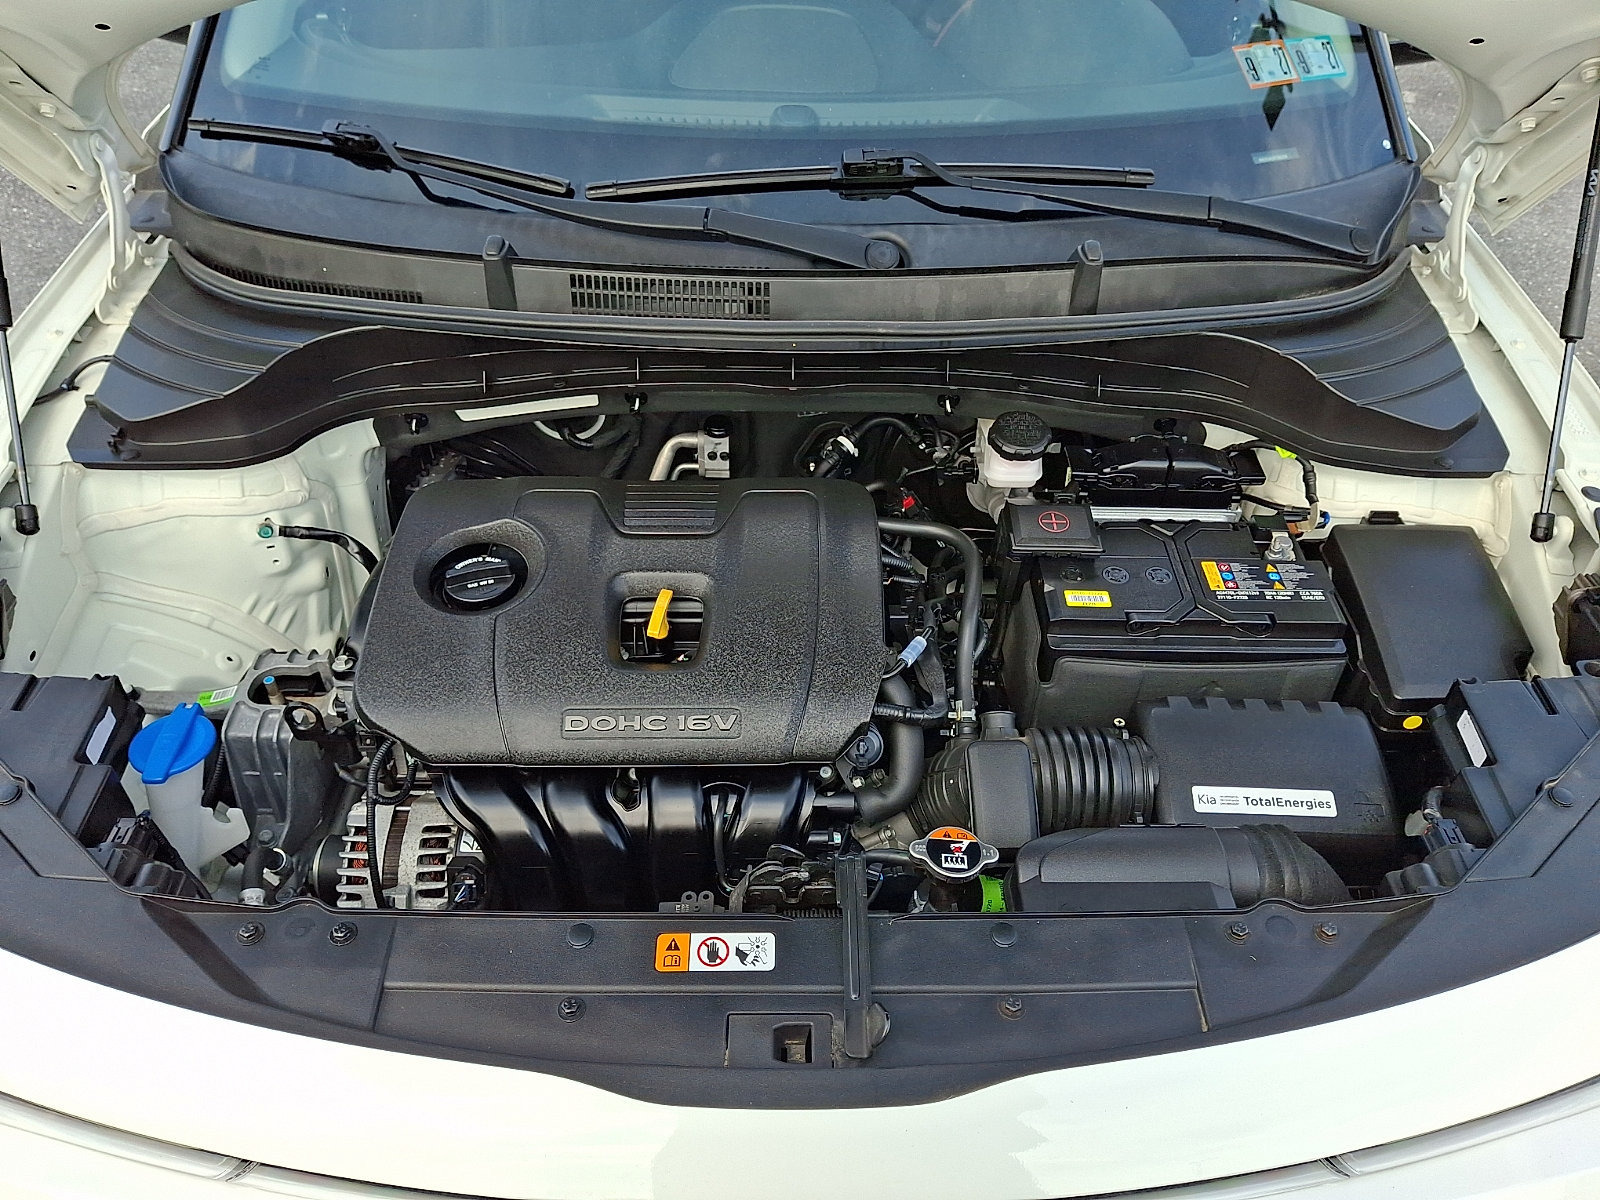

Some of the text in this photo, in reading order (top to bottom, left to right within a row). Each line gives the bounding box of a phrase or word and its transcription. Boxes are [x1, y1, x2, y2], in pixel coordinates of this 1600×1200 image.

[564, 714, 739, 732] DOHC 16V
[1197, 793, 1217, 805] Kia
[1243, 796, 1332, 810] TotalEnergies
